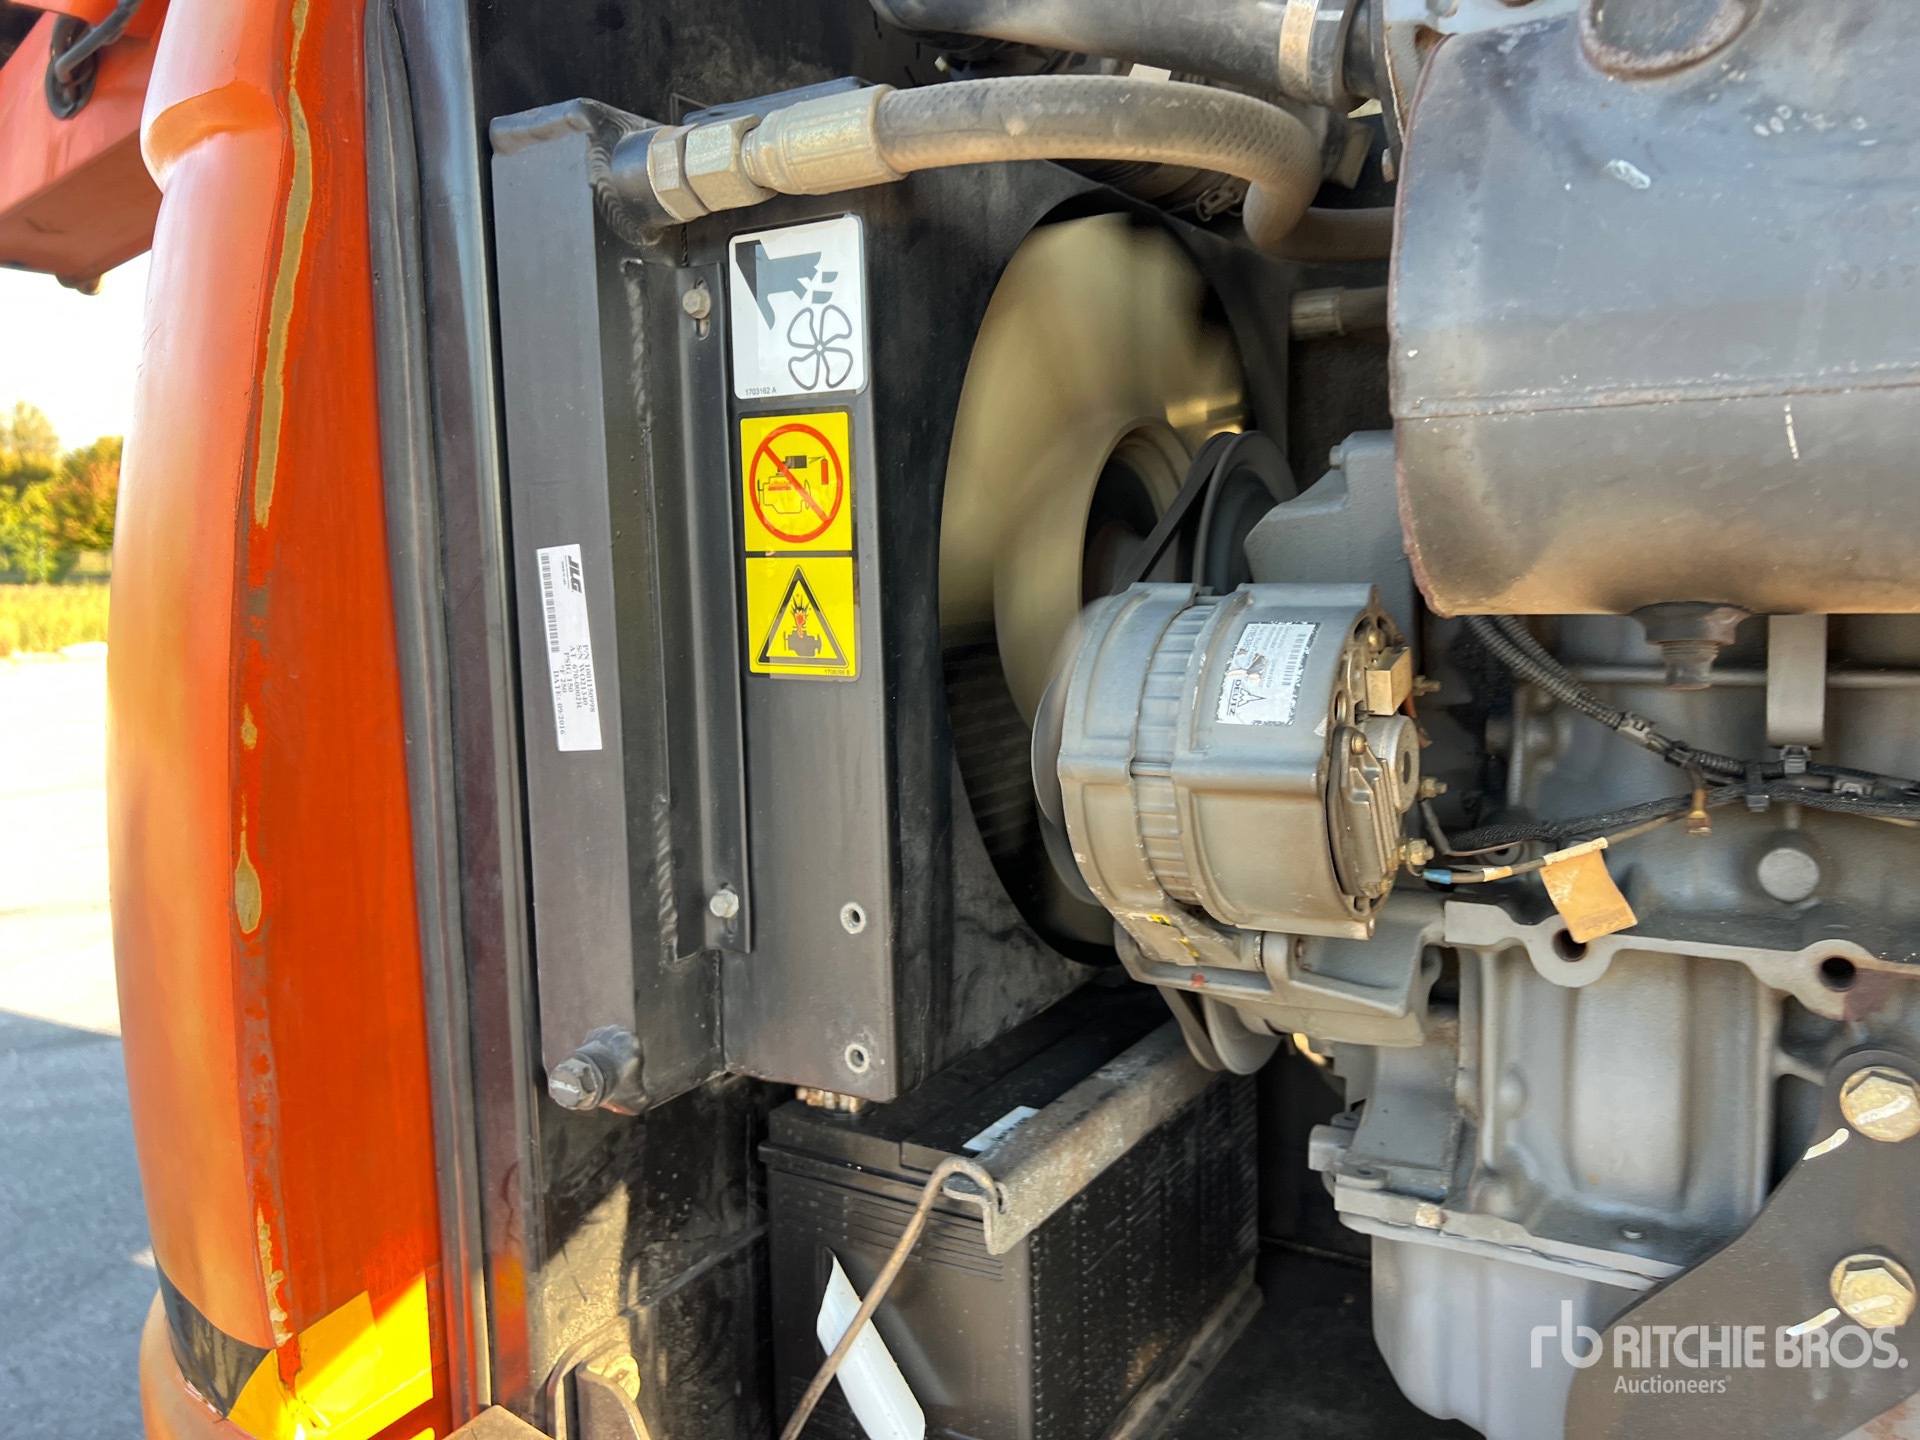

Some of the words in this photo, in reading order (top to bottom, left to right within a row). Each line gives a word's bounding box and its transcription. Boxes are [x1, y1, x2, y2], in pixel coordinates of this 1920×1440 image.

[745, 387, 770, 395] 1703162
[568, 556, 582, 593] JLG
[564, 653, 572, 674] PSIG
[570, 645, 577, 658] AT
[553, 671, 561, 700] DATE:
[557, 703, 565, 735] 09/2016
[1228, 679, 1241, 715] DEUTZ
